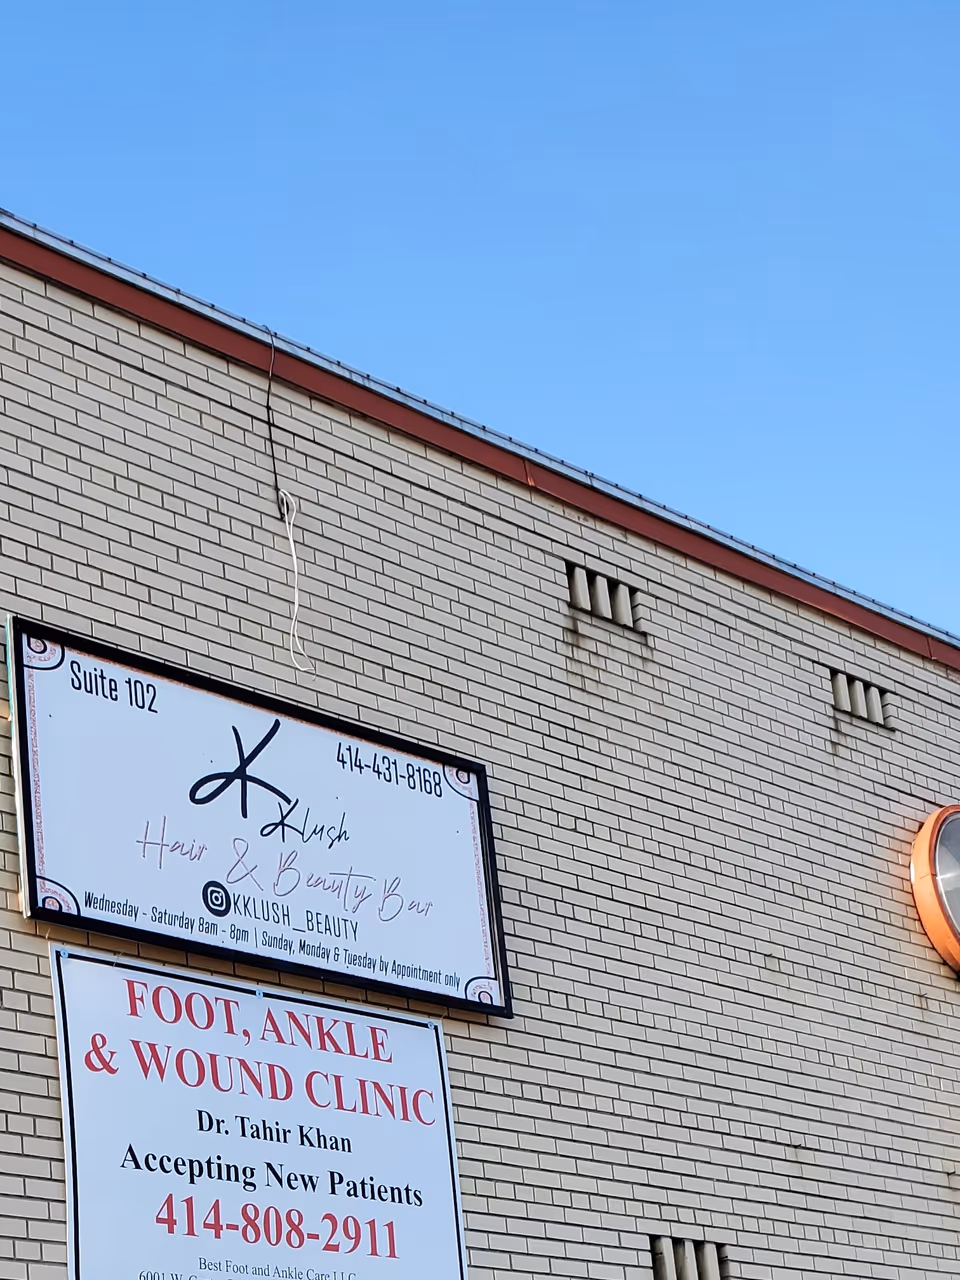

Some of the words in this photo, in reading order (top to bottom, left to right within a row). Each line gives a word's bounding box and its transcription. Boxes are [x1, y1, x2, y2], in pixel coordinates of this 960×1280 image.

[70, 660, 119, 702] Suite
[125, 678, 158, 714] 102
[336, 742, 443, 797] 414-431-8168
[260, 798, 350, 849] Klush
[136, 815, 208, 870] Hair
[225, 837, 264, 892] &
[273, 850, 376, 913] Beauty
[377, 876, 434, 922] Bar
[84, 891, 139, 922] Wednesday
[151, 906, 195, 935] Saturday
[198, 917, 218, 936] 8am
[229, 924, 249, 944] 8pm
[262, 931, 295, 955] Sunday,
[299, 939, 330, 963] Monday
[334, 947, 340, 962] &
[343, 949, 376, 974] Tuesday
[379, 956, 389, 975] by
[391, 960, 441, 984] Appointment
[444, 972, 461, 991] only
[232, 892, 359, 942] KKLUSH_BEAUTY
[123, 977, 251, 1047] FOOT,
[259, 1007, 393, 1064] ANKLE
[83, 1032, 119, 1076] &
[129, 1038, 294, 1102] WOUND
[305, 1070, 436, 1127] CLINIC
[196, 1109, 230, 1136] Dr.
[235, 1114, 291, 1145] Tahir
[298, 1123, 352, 1154] Khan
[120, 1143, 257, 1192] Accepting
[264, 1161, 319, 1194] New
[329, 1170, 424, 1208] Patients
[155, 1193, 400, 1260] 414-808-2911
[198, 1257, 222, 1271] Best
[225, 1260, 249, 1275] Foot
[251, 1264, 270, 1277] and
[272, 1265, 303, 1280] Ankle
